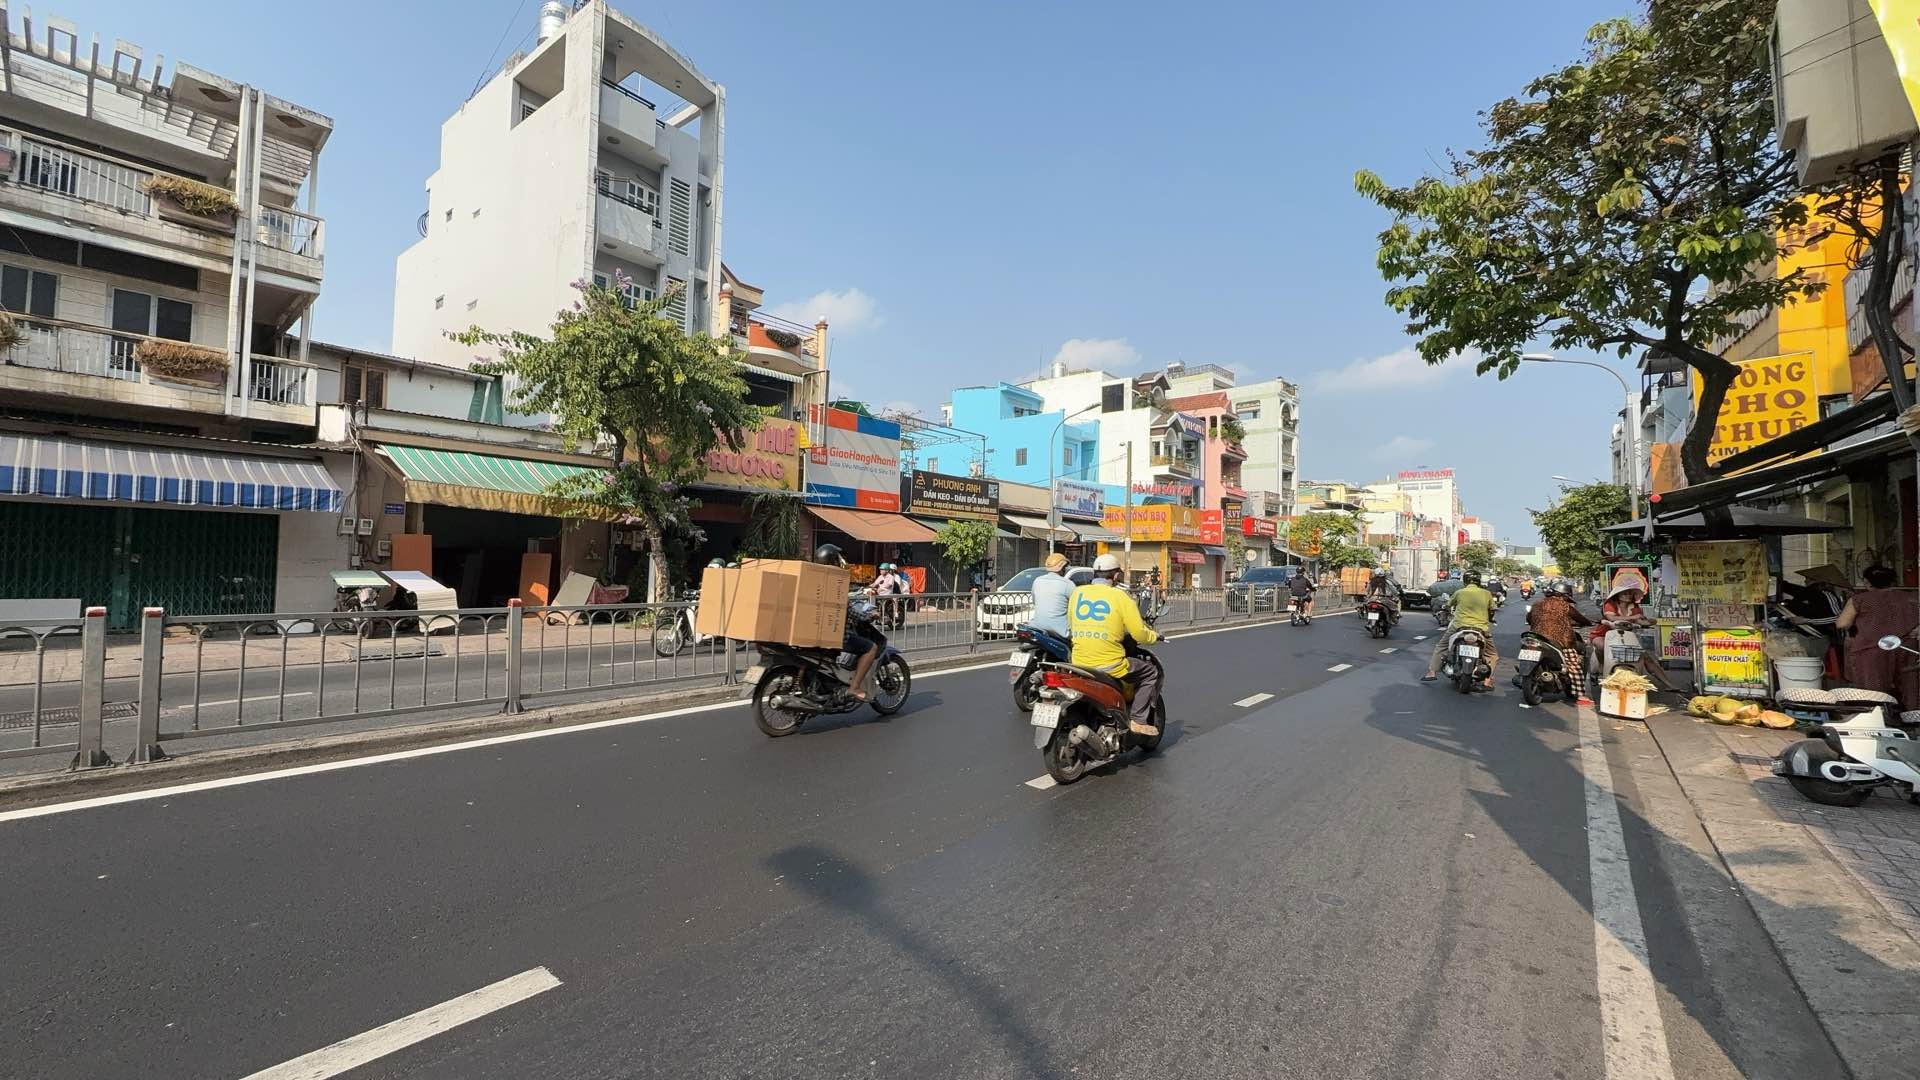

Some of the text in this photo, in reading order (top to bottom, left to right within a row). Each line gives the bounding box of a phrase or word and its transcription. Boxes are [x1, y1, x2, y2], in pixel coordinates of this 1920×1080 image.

[1729, 362, 1805, 389] ÒNG
[829, 446, 897, 468] GiaoHangNhanh
[932, 478, 982, 494] PHƯƠNG ANH
[1075, 592, 1111, 622] be
